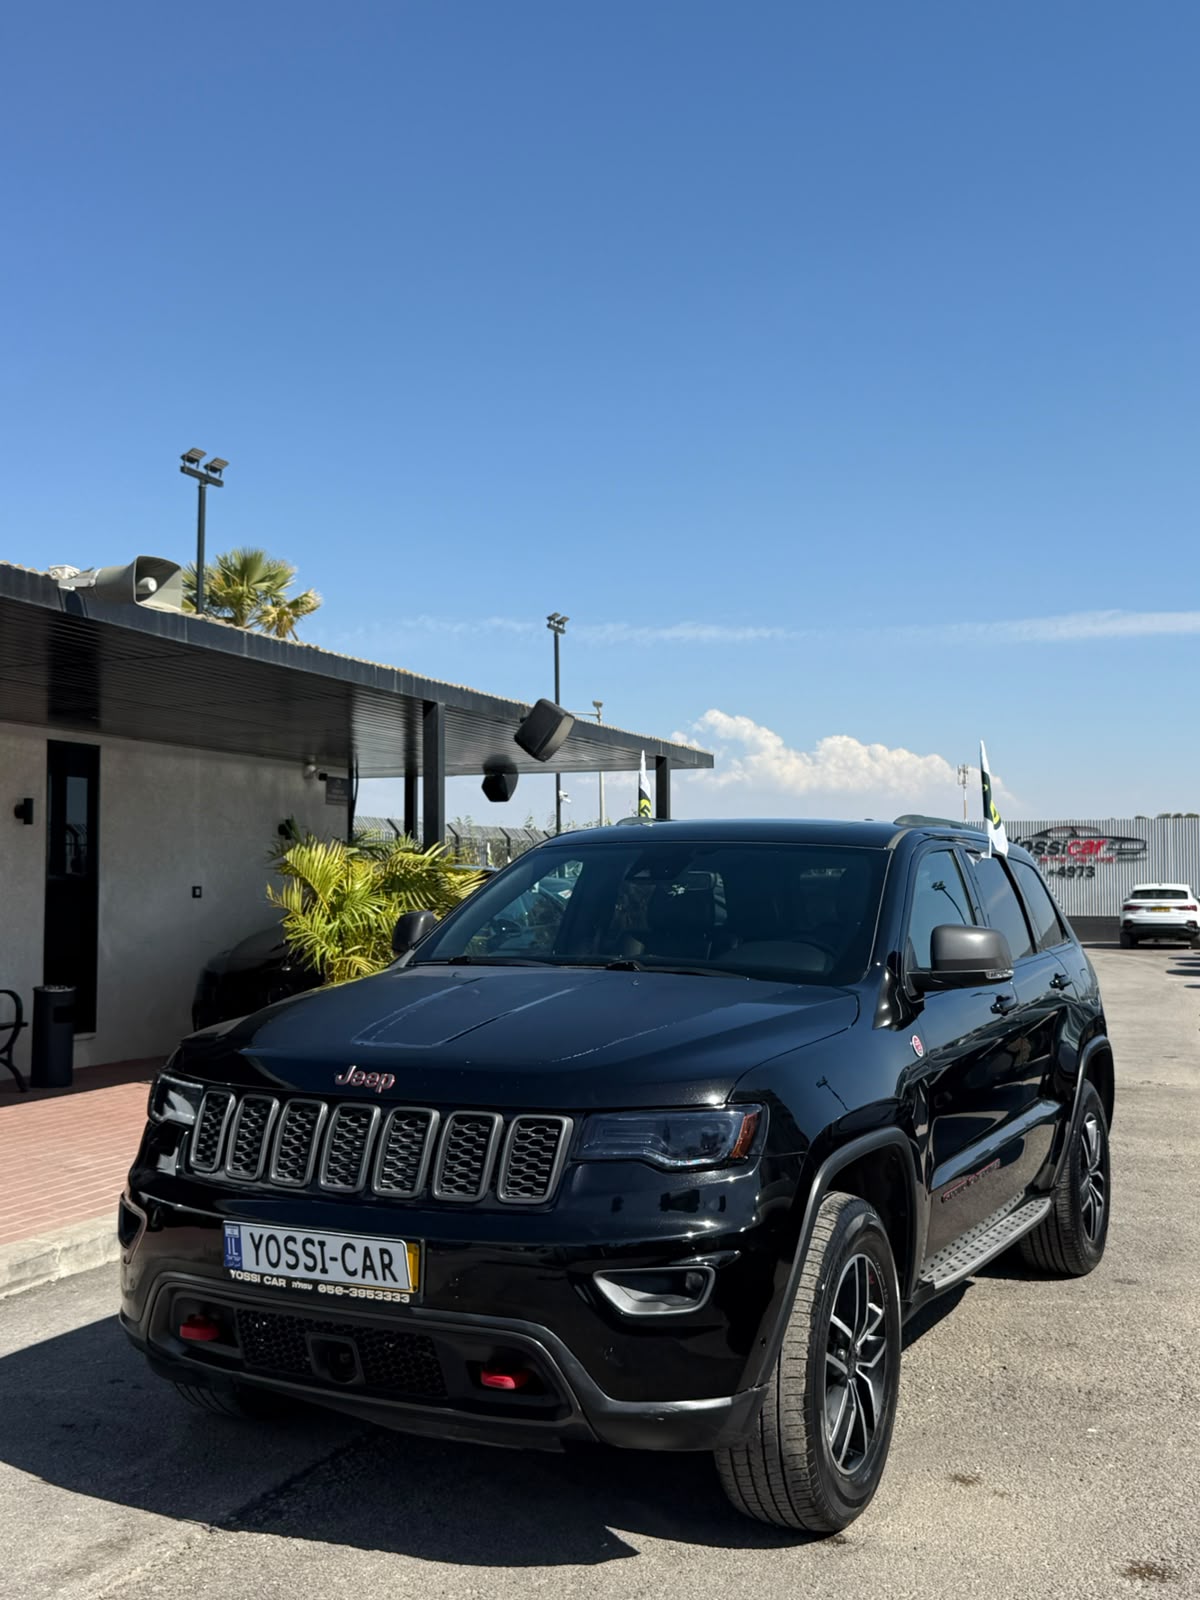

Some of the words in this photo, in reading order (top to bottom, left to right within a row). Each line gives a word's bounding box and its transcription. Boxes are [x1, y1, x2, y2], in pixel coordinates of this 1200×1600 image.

[335, 1065, 395, 1093] Jeep
[227, 1237, 239, 1256] IL
[249, 1232, 398, 1282] YOSSI-CAR
[229, 1269, 261, 1283] YOSSI
[263, 1275, 287, 1288] CAR
